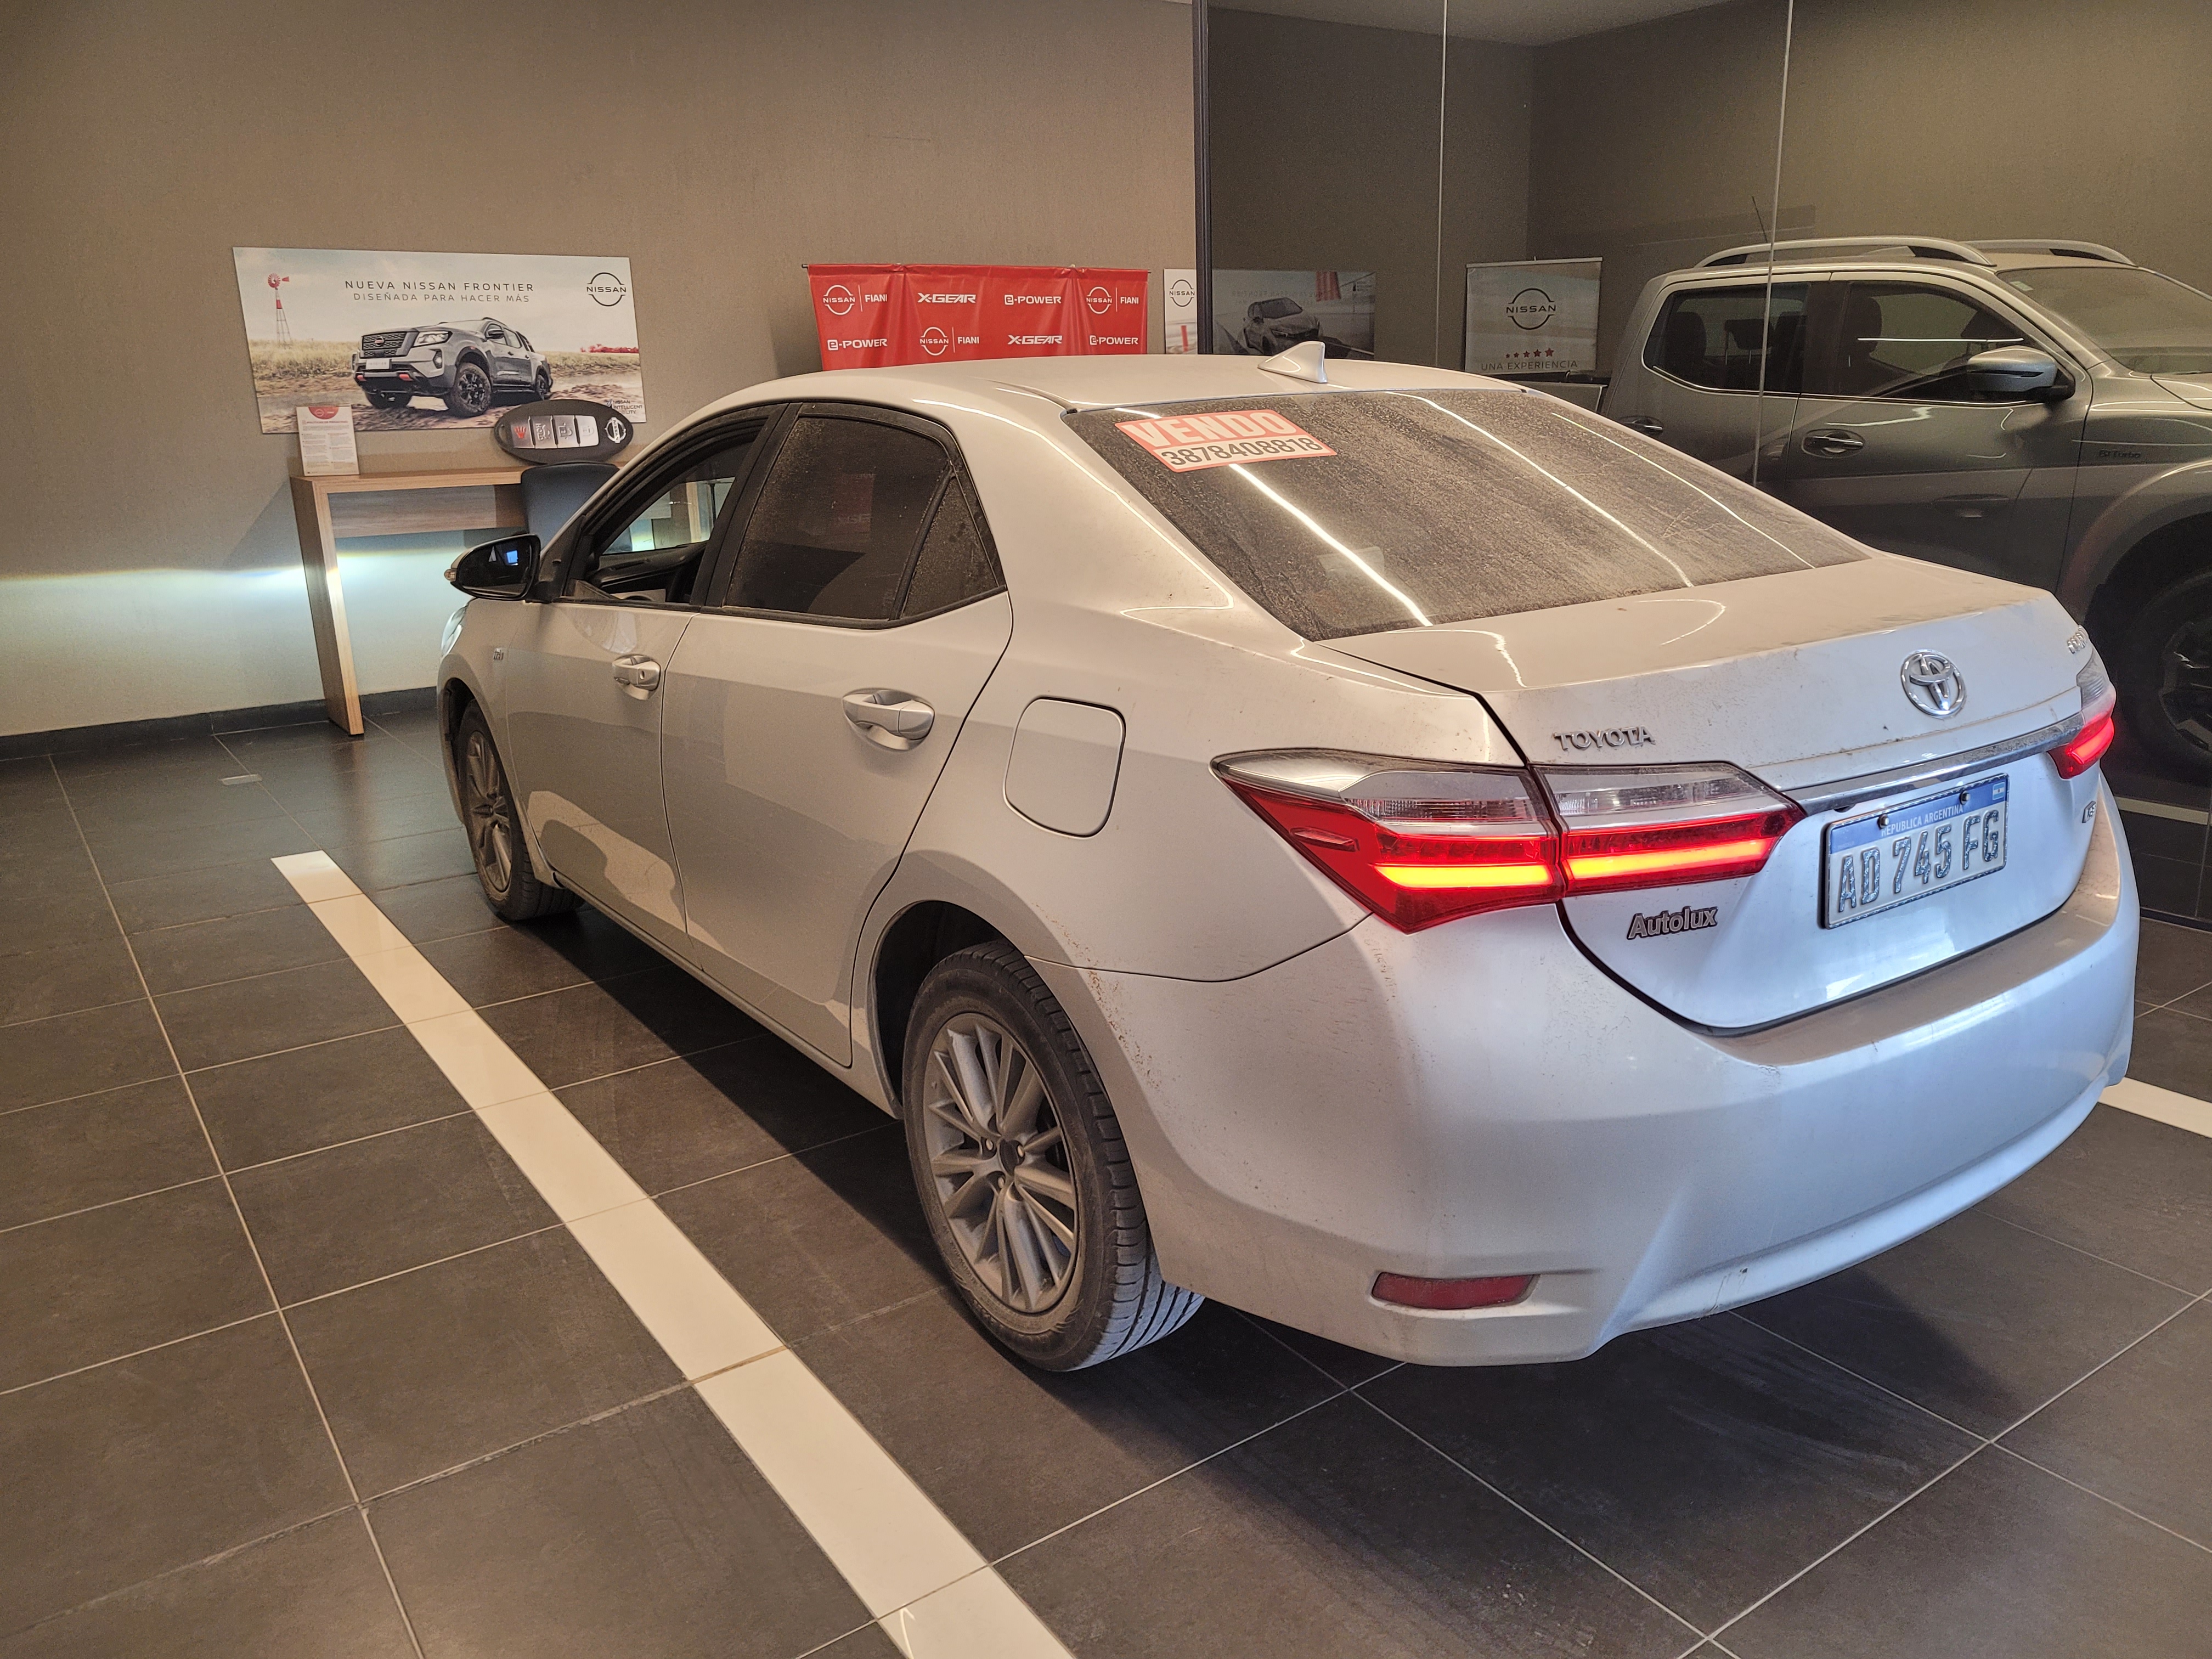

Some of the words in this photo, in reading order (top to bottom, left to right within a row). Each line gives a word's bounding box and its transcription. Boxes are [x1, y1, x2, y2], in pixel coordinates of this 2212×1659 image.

[345, 280, 396, 290] NUEVA
[403, 281, 456, 291] NISSAN
[464, 283, 534, 292] FRONTIER
[353, 292, 417, 301] DISEÑADA
[506, 294, 529, 302] MÁS
[865, 294, 888, 302] FIANI
[917, 293, 977, 303] X-GEAR
[1120, 296, 1139, 304] FIANI
[1506, 304, 1556, 314] NISSAN
[1007, 335, 1063, 345] X-GEAR
[1481, 363, 1503, 371] UNA
[1508, 360, 1578, 370] EXPERIENCIA
[1121, 412, 1297, 447] VENDO
[1161, 438, 1323, 465] 3878408818
[1554, 725, 1656, 751] TOYOTA
[1925, 804, 1964, 823] ARGENTINA
[1838, 848, 1880, 912] AD
[1893, 823, 1952, 894] 745
[1962, 809, 2000, 871] FG
[1627, 906, 1718, 940] Autolux
